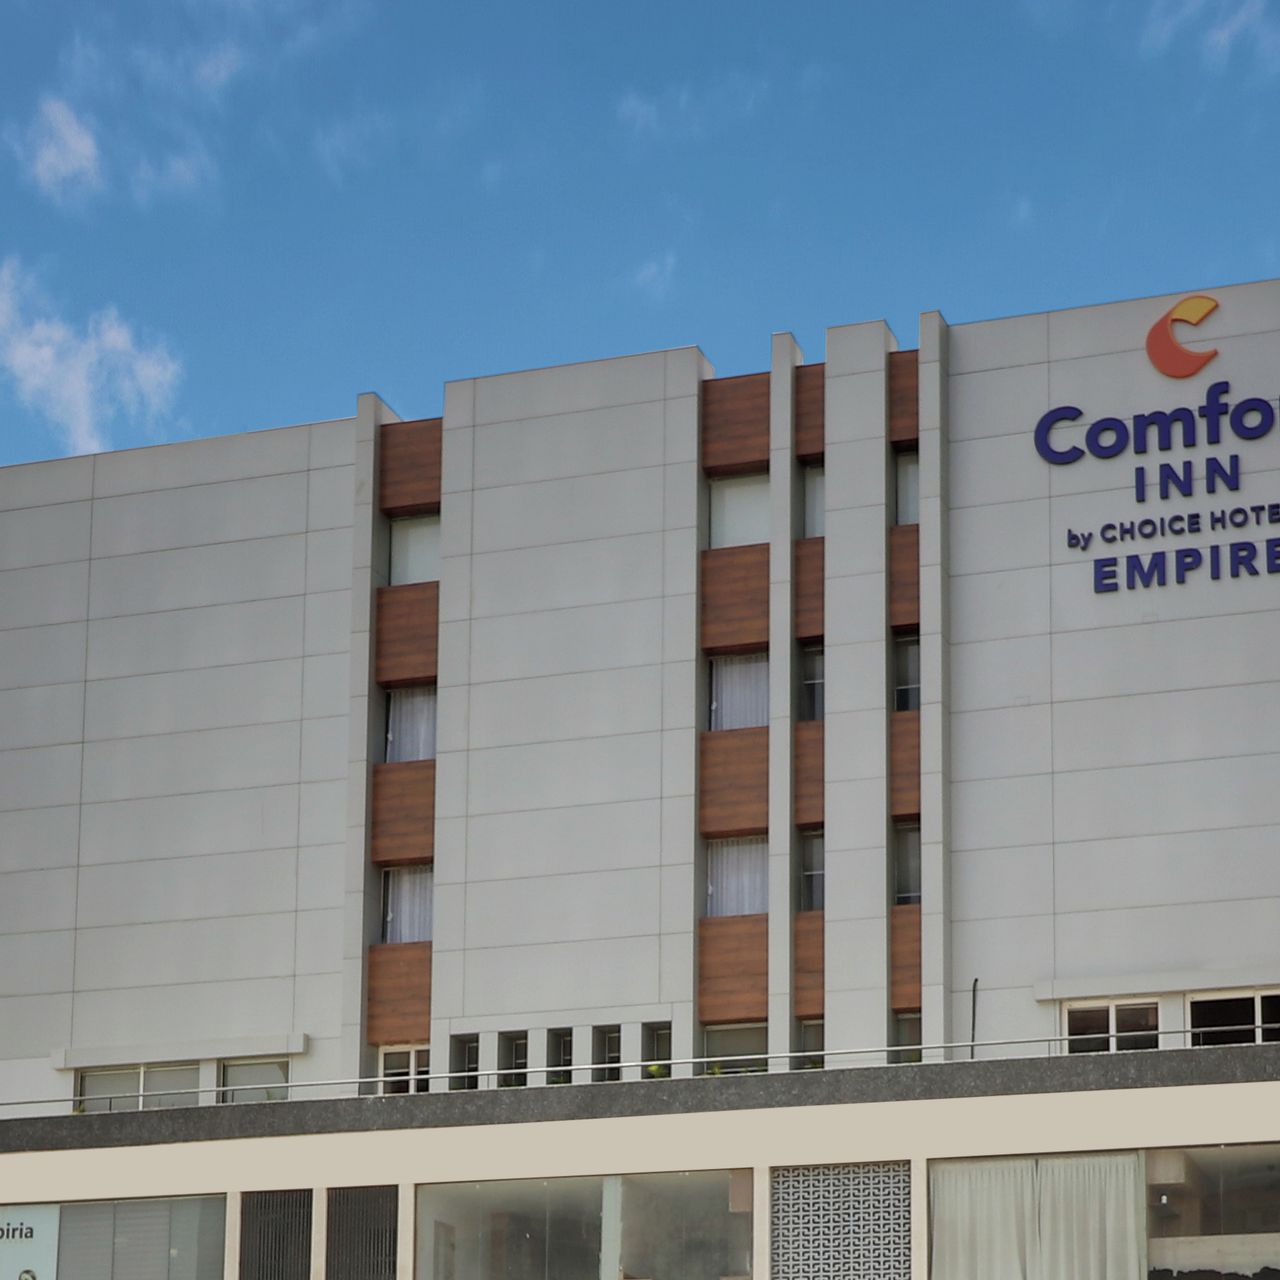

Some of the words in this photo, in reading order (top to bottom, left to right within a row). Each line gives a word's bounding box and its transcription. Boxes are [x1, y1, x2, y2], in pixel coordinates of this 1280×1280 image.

[1135, 455, 1240, 502] INN
[1067, 529, 1094, 551] by
[1100, 512, 1201, 544] CHOICE
